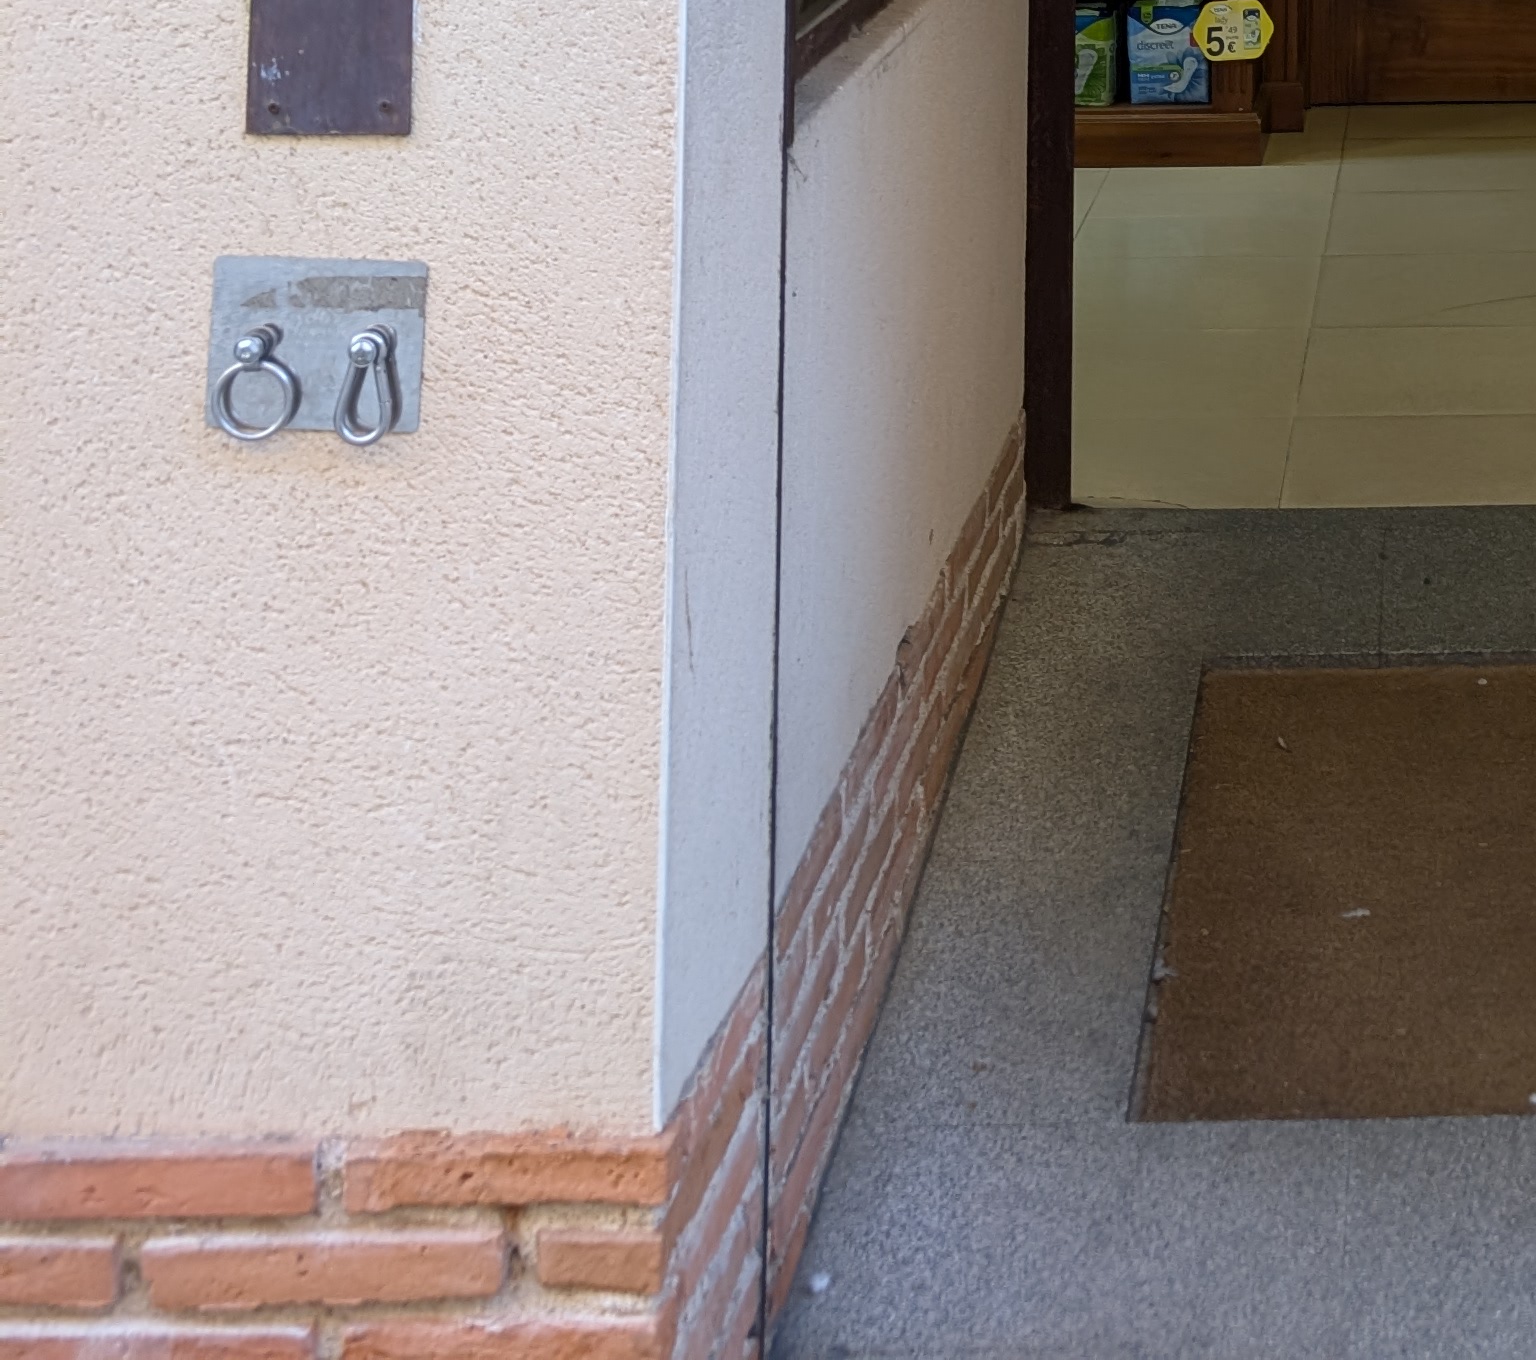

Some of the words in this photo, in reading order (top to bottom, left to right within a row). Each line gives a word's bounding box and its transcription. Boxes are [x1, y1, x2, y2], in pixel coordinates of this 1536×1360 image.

[1136, 40, 1175, 51] discreet
[1206, 26, 1225, 56] 5
[1227, 41, 1237, 53] €
